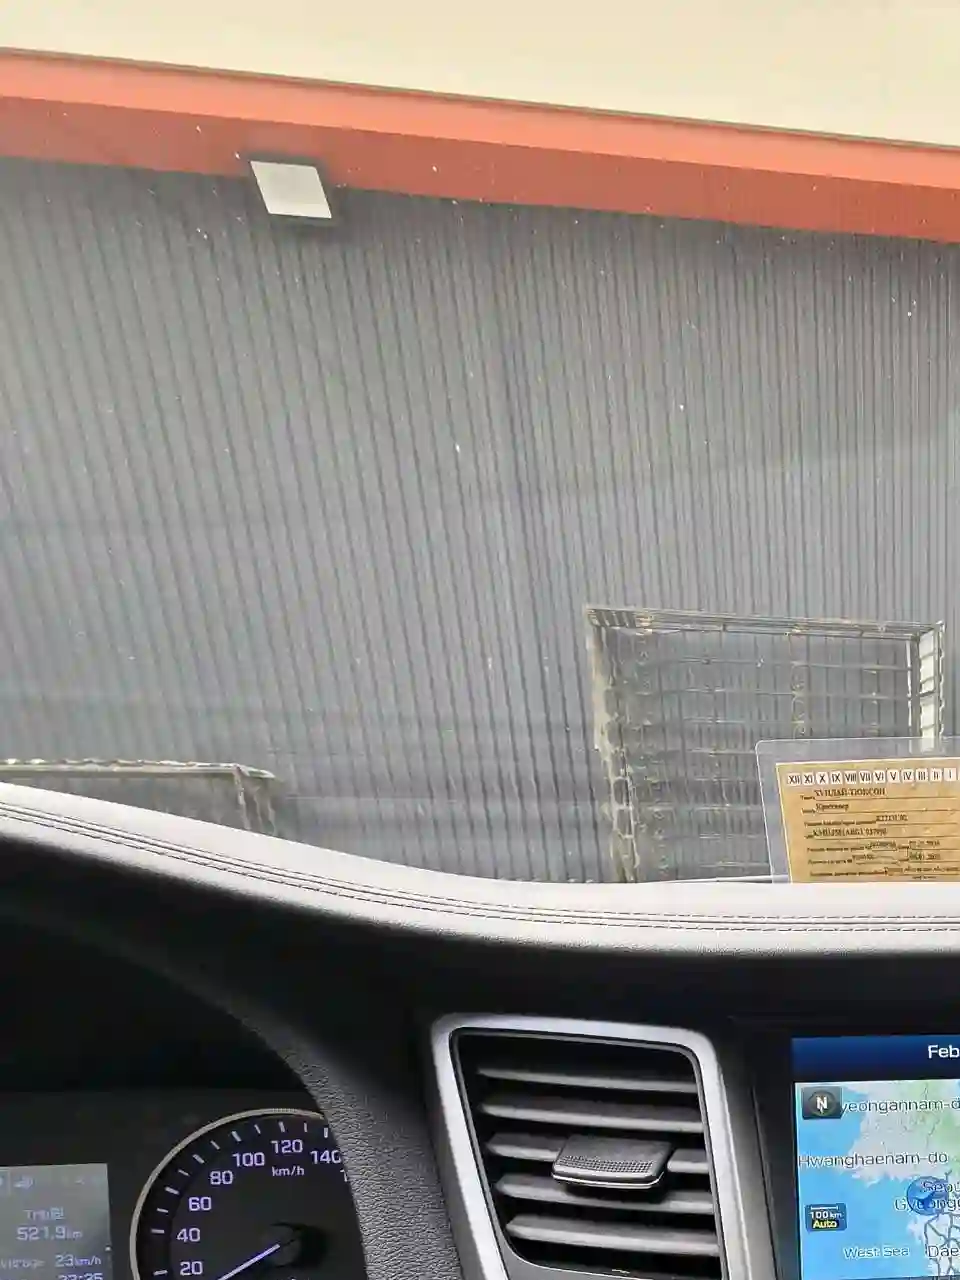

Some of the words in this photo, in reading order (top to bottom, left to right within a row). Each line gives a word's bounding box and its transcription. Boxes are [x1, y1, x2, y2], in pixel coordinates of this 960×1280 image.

[271, 1139, 303, 1154] 120
[232, 1151, 265, 1167] 100
[310, 1149, 342, 1164] 140
[209, 1170, 234, 1186] 80
[271, 1164, 305, 1178] km/h
[188, 1196, 212, 1212] 60
[176, 1227, 201, 1242] 40
[843, 1246, 879, 1258] West
[883, 1246, 910, 1257] Sea
[180, 1261, 203, 1276] 20
